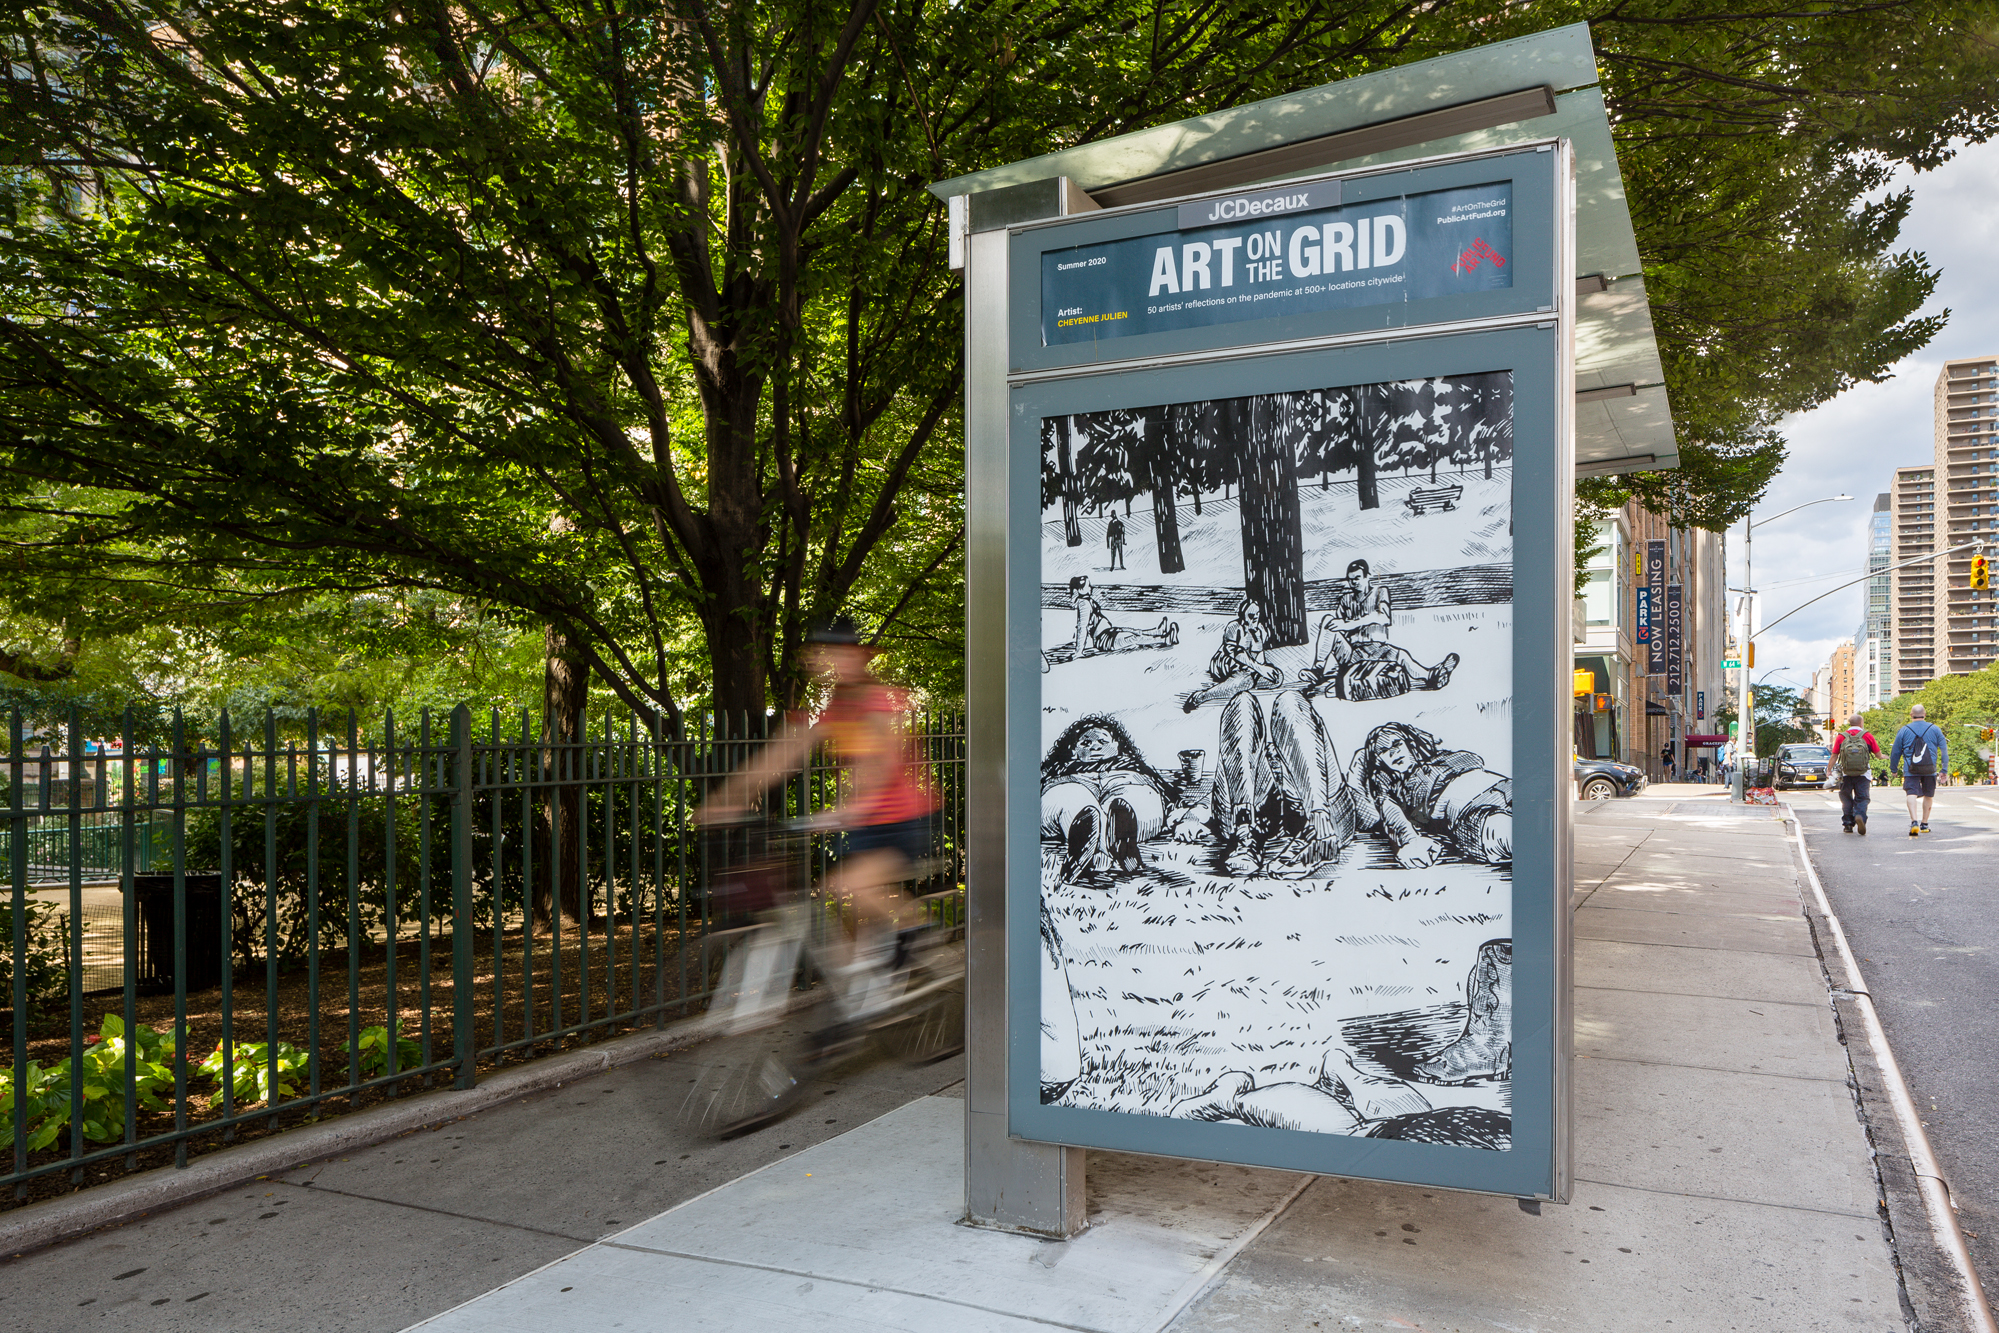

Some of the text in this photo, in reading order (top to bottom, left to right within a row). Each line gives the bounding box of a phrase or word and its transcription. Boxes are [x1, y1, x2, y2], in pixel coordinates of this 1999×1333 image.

[1208, 193, 1309, 221] JCDecaux
[1437, 209, 1505, 224] PublicArtFund.org
[1451, 198, 1506, 212] #ArtOnTheGrid
[1246, 230, 1281, 260] ON
[1288, 214, 1407, 278] GRID
[1450, 237, 1485, 273] PUBLIC
[1481, 243, 1506, 268] FUND
[1057, 256, 1107, 271] Summer 2020
[1148, 237, 1243, 297] ART
[1245, 259, 1283, 283] THE
[1147, 306, 1157, 315] 50
[1185, 298, 1225, 309] reflections
[1226, 296, 1237, 304] on
[1239, 294, 1252, 303] the
[1253, 288, 1293, 302] pandemic
[1294, 287, 1303, 296] at
[1304, 285, 1327, 294] 500+
[1328, 280, 1366, 291] locations
[1367, 274, 1403, 287] citywide
[1057, 307, 1083, 317] Artist:
[1057, 311, 1128, 327] CHEYENNE JULIEN
[1651, 559, 1662, 620] LEASING
[1639, 591, 1648, 626] PARK
[1651, 626, 1663, 662] NOW
[1669, 601, 1680, 686] 212.712.2500
